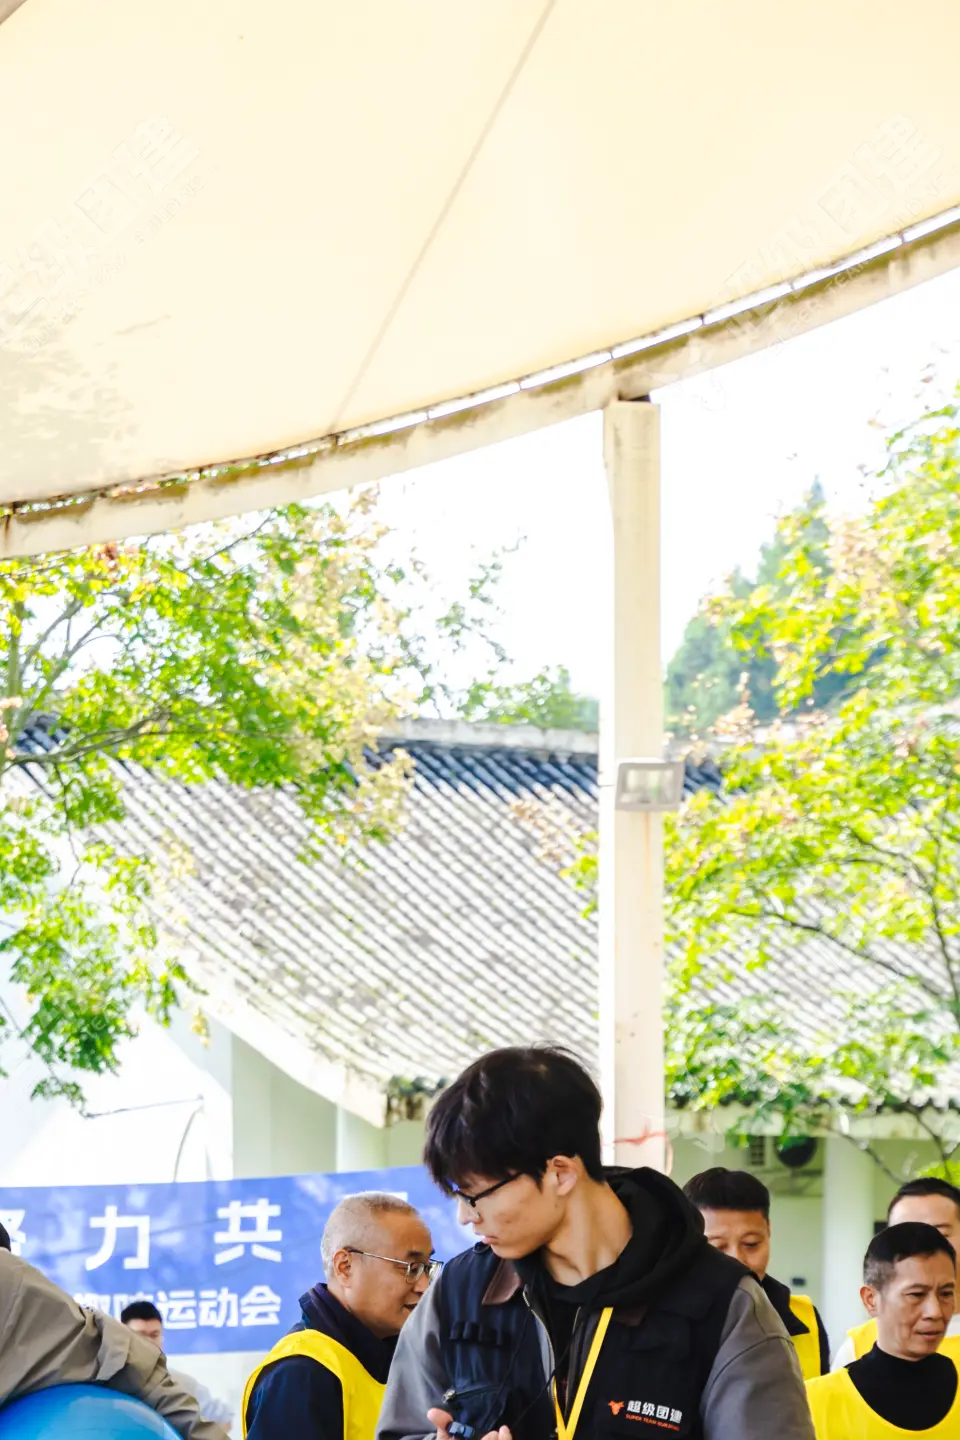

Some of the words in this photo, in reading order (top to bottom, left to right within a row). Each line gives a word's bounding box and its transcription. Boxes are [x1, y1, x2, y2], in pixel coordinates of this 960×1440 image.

[627, 1400, 682, 1424] 超级团建
[643, 1417, 657, 1425] TEAM
